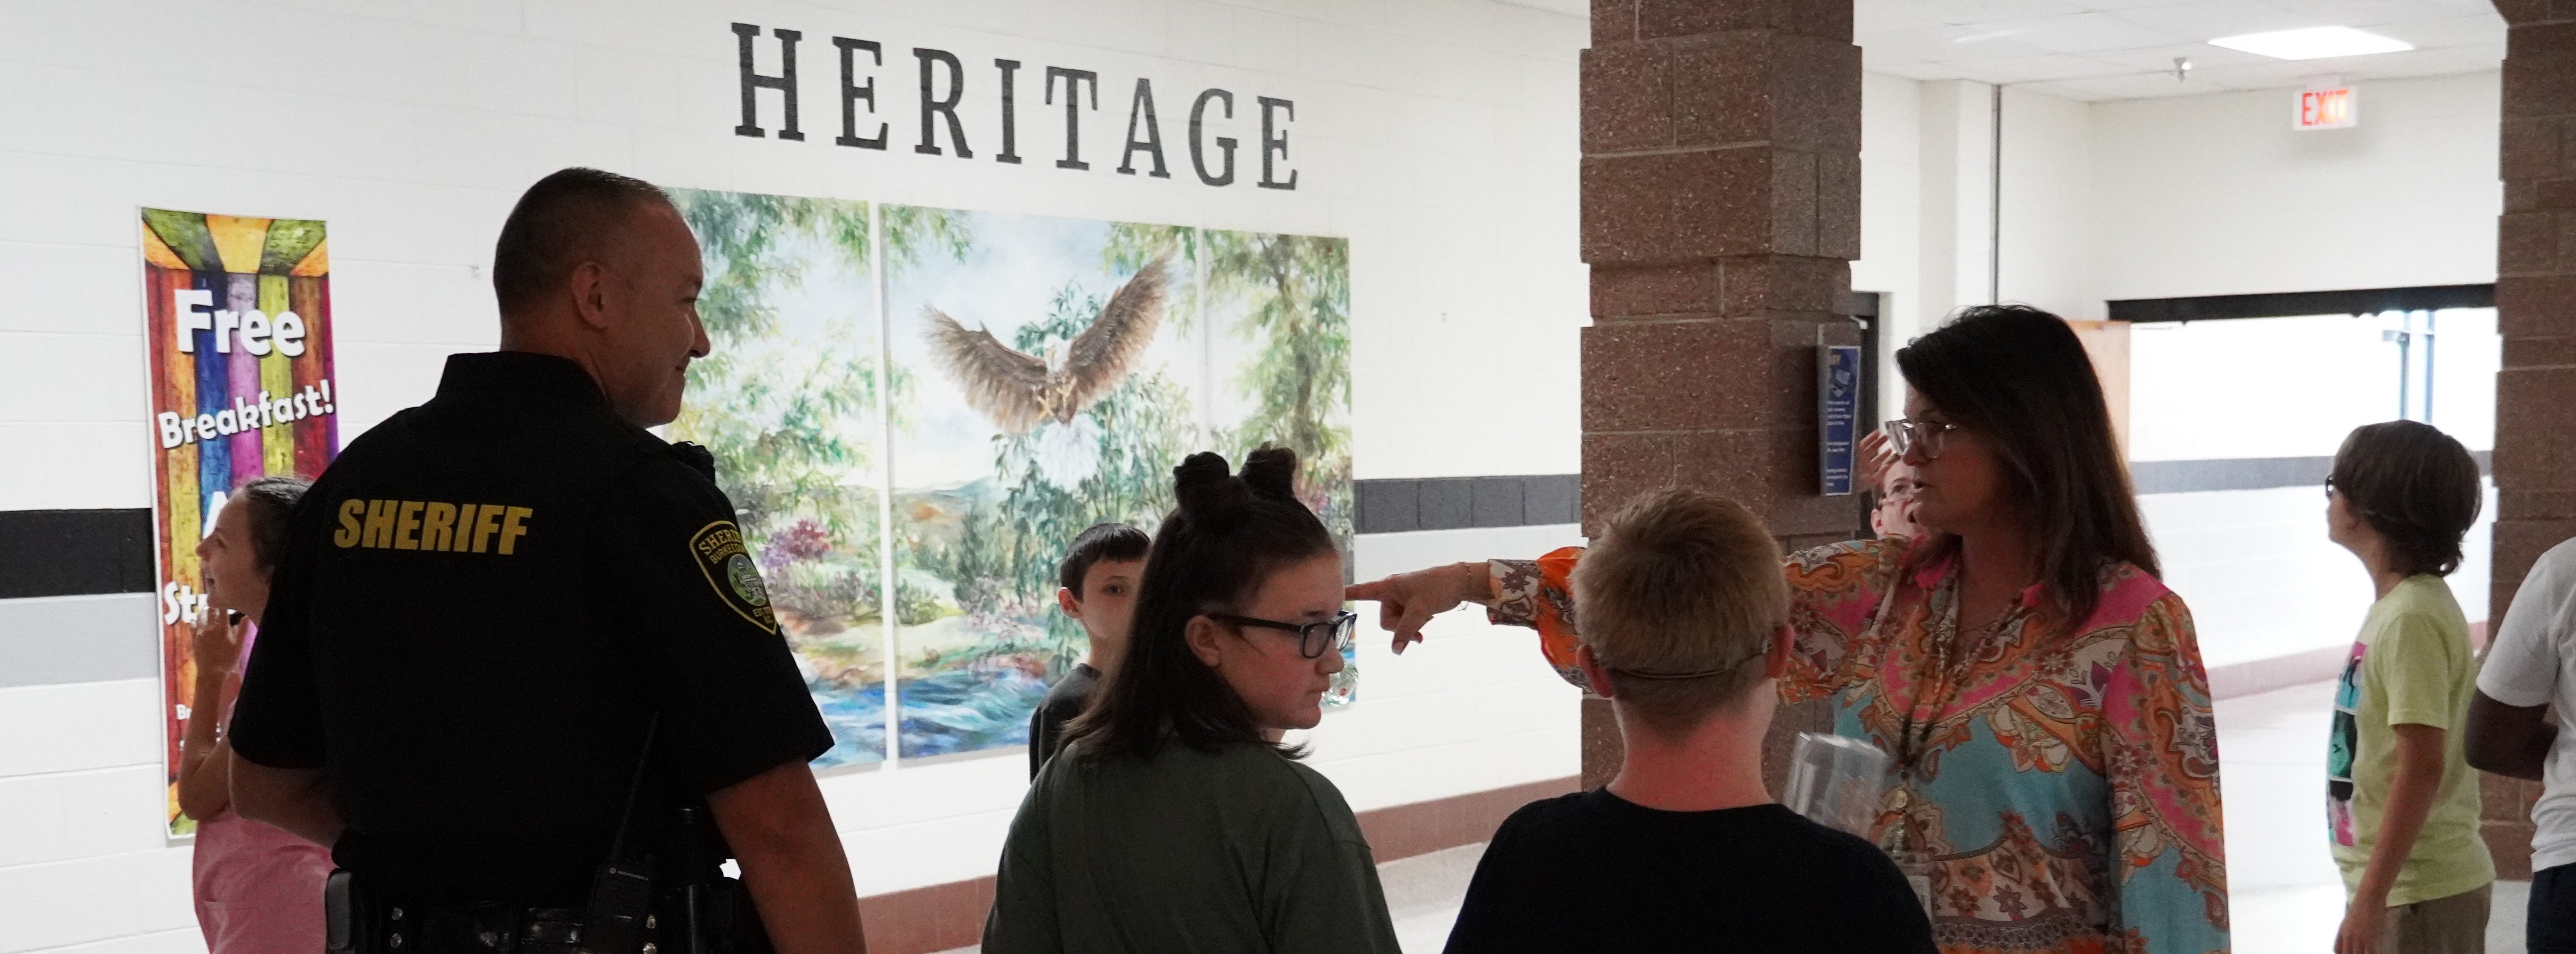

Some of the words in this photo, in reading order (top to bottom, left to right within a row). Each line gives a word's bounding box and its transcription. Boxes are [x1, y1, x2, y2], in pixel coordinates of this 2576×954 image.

[731, 22, 1297, 191] HERITAGE
[2301, 89, 2348, 126] EXIT
[174, 289, 306, 356] Free
[158, 379, 335, 449] Breakfast!
[333, 499, 534, 555] SHERIFF
